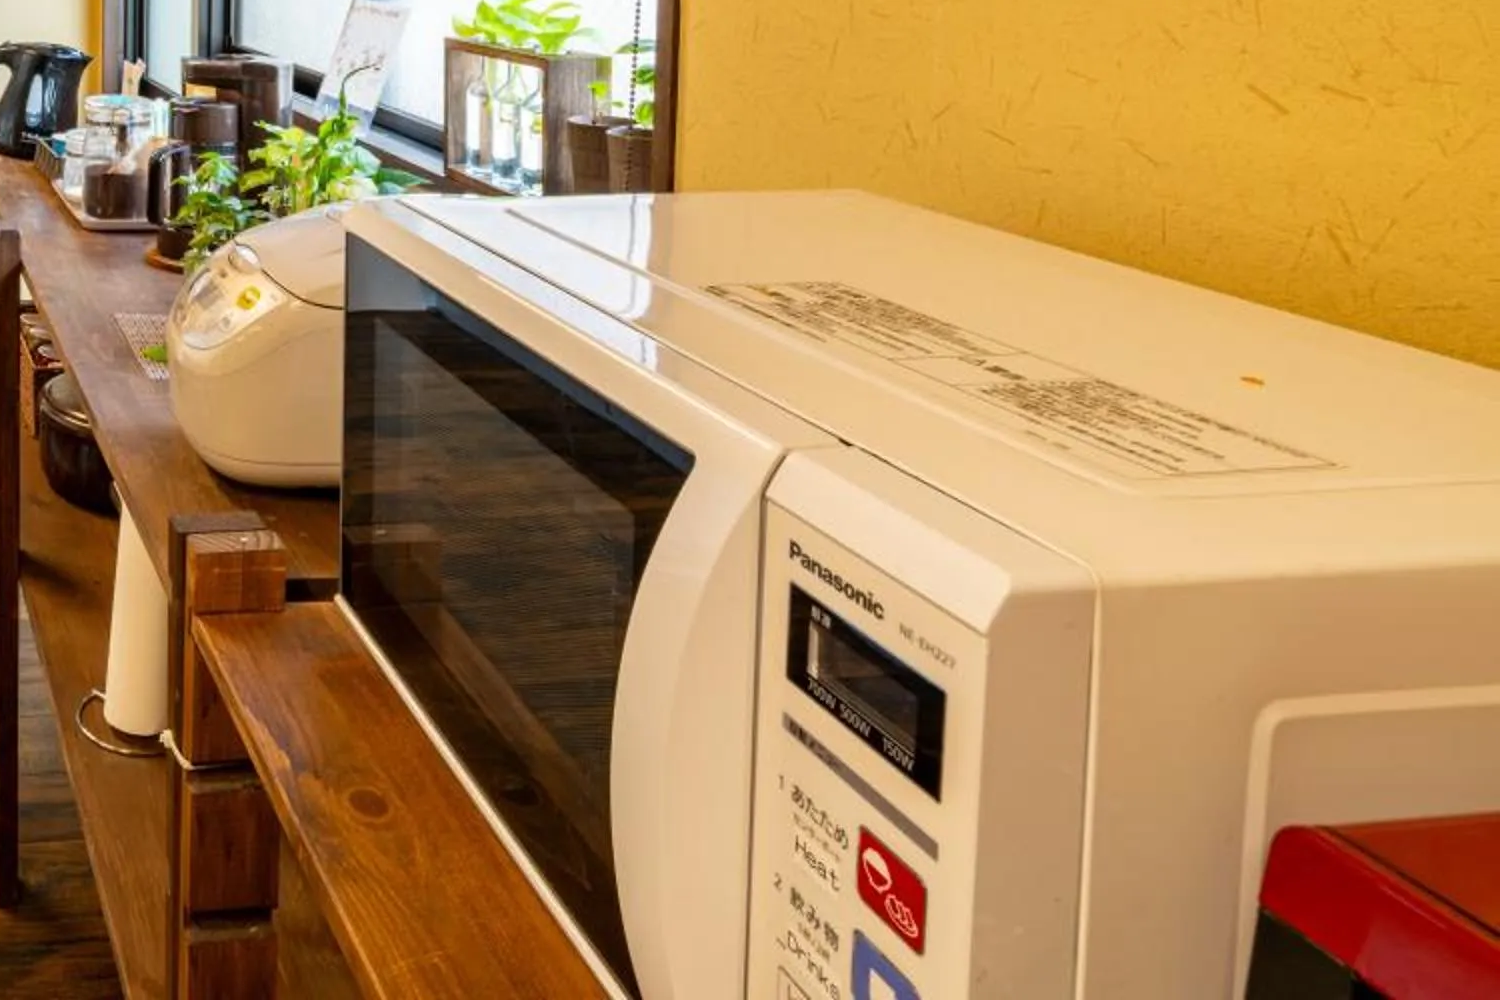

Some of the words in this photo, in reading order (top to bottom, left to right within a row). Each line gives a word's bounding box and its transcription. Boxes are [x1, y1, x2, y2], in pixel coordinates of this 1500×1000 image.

[789, 538, 885, 620] Panasonic
[839, 701, 872, 738] 500W
[881, 737, 915, 771] 150W
[791, 784, 849, 850] あたため
[794, 835, 840, 892] Heat
[790, 886, 839, 952] 飲み物
